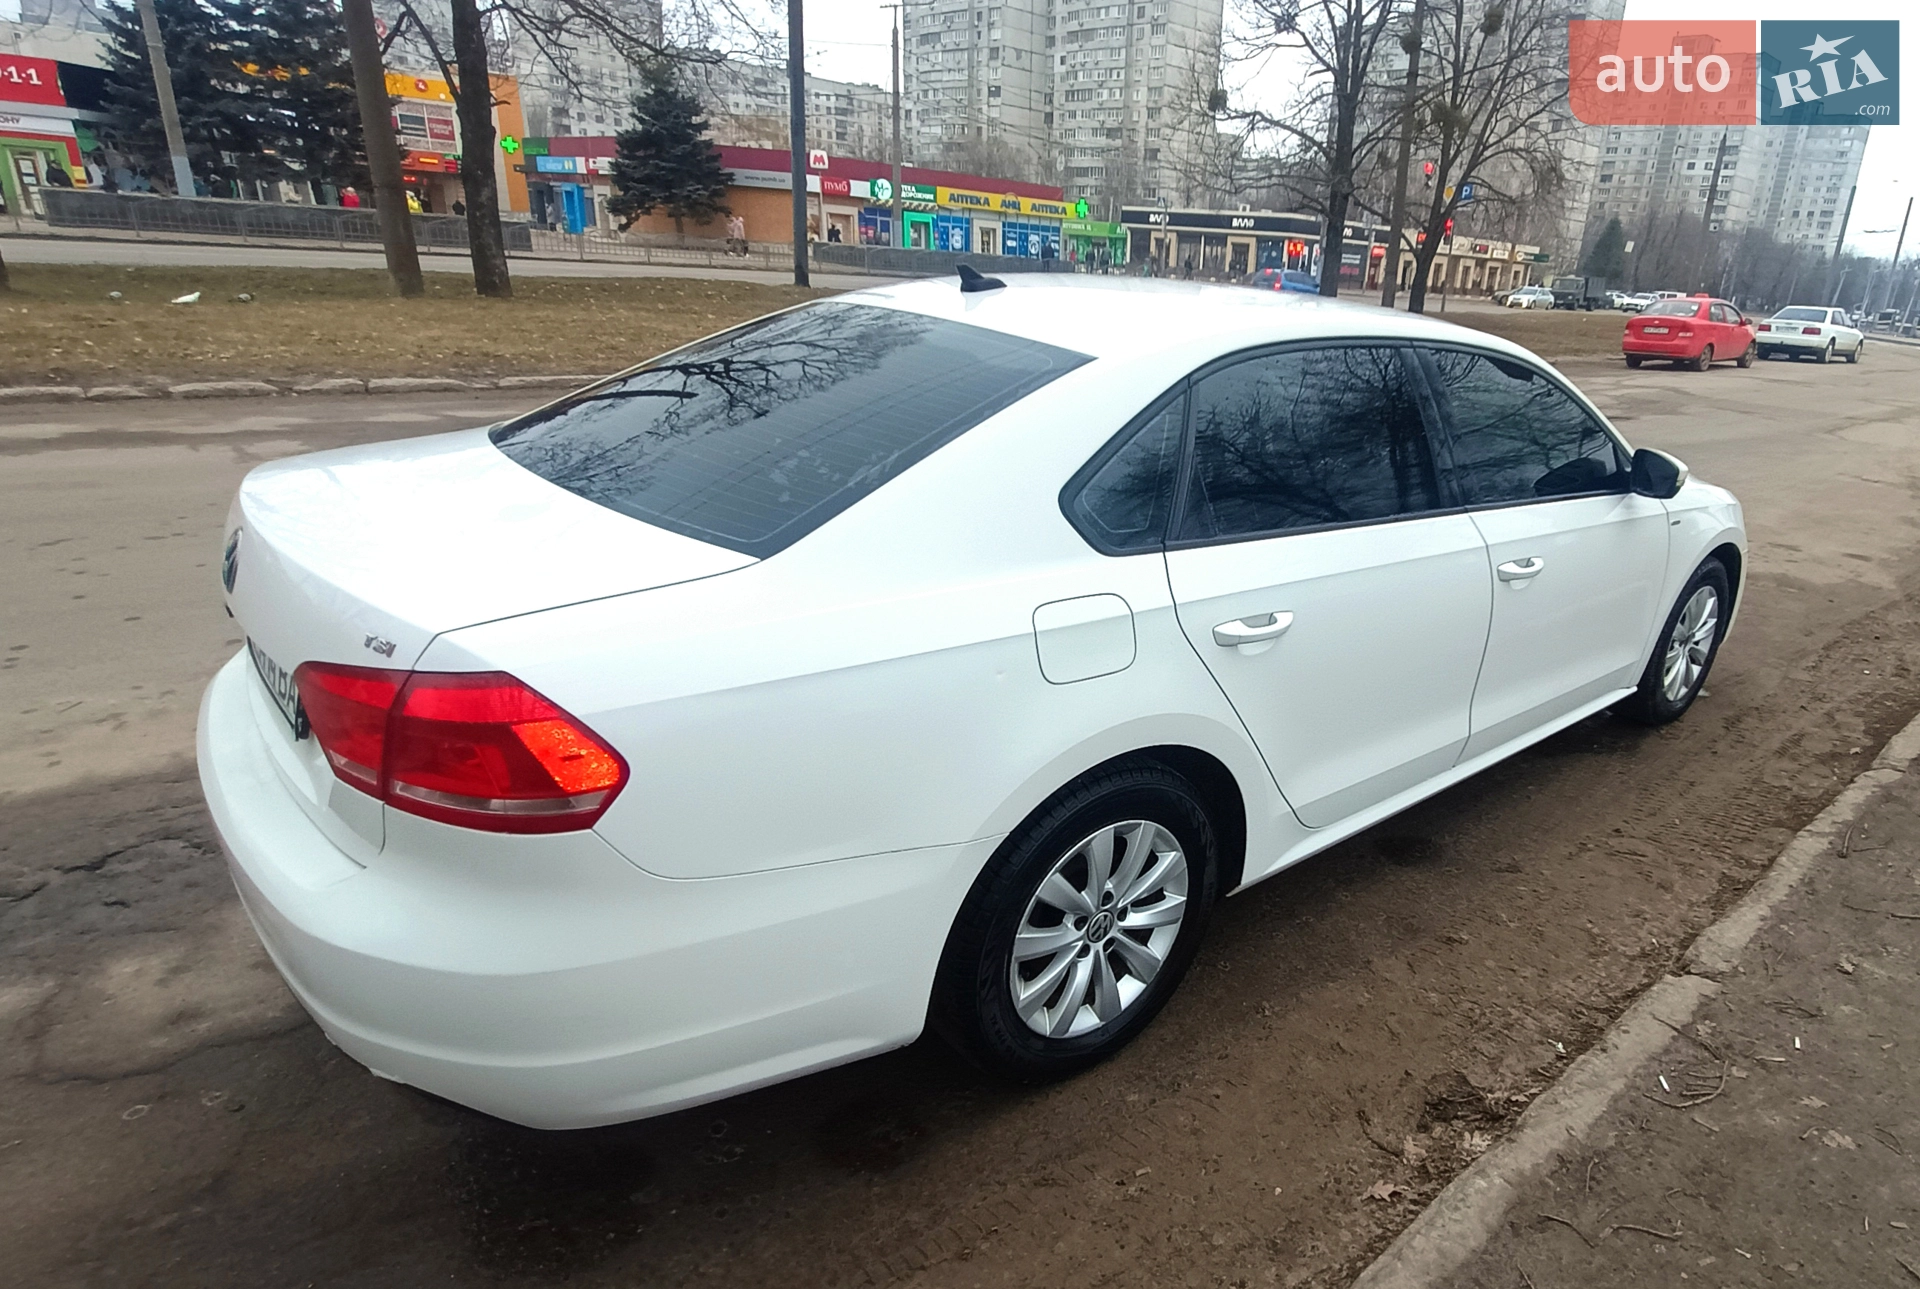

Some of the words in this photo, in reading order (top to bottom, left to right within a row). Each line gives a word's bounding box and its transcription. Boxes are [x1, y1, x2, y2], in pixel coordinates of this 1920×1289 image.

[948, 192, 990, 207] АПТЕКА
[1000, 199, 1021, 212] АНЦ
[1030, 203, 1067, 216] АПТЕКА
[364, 632, 397, 658] TSI
